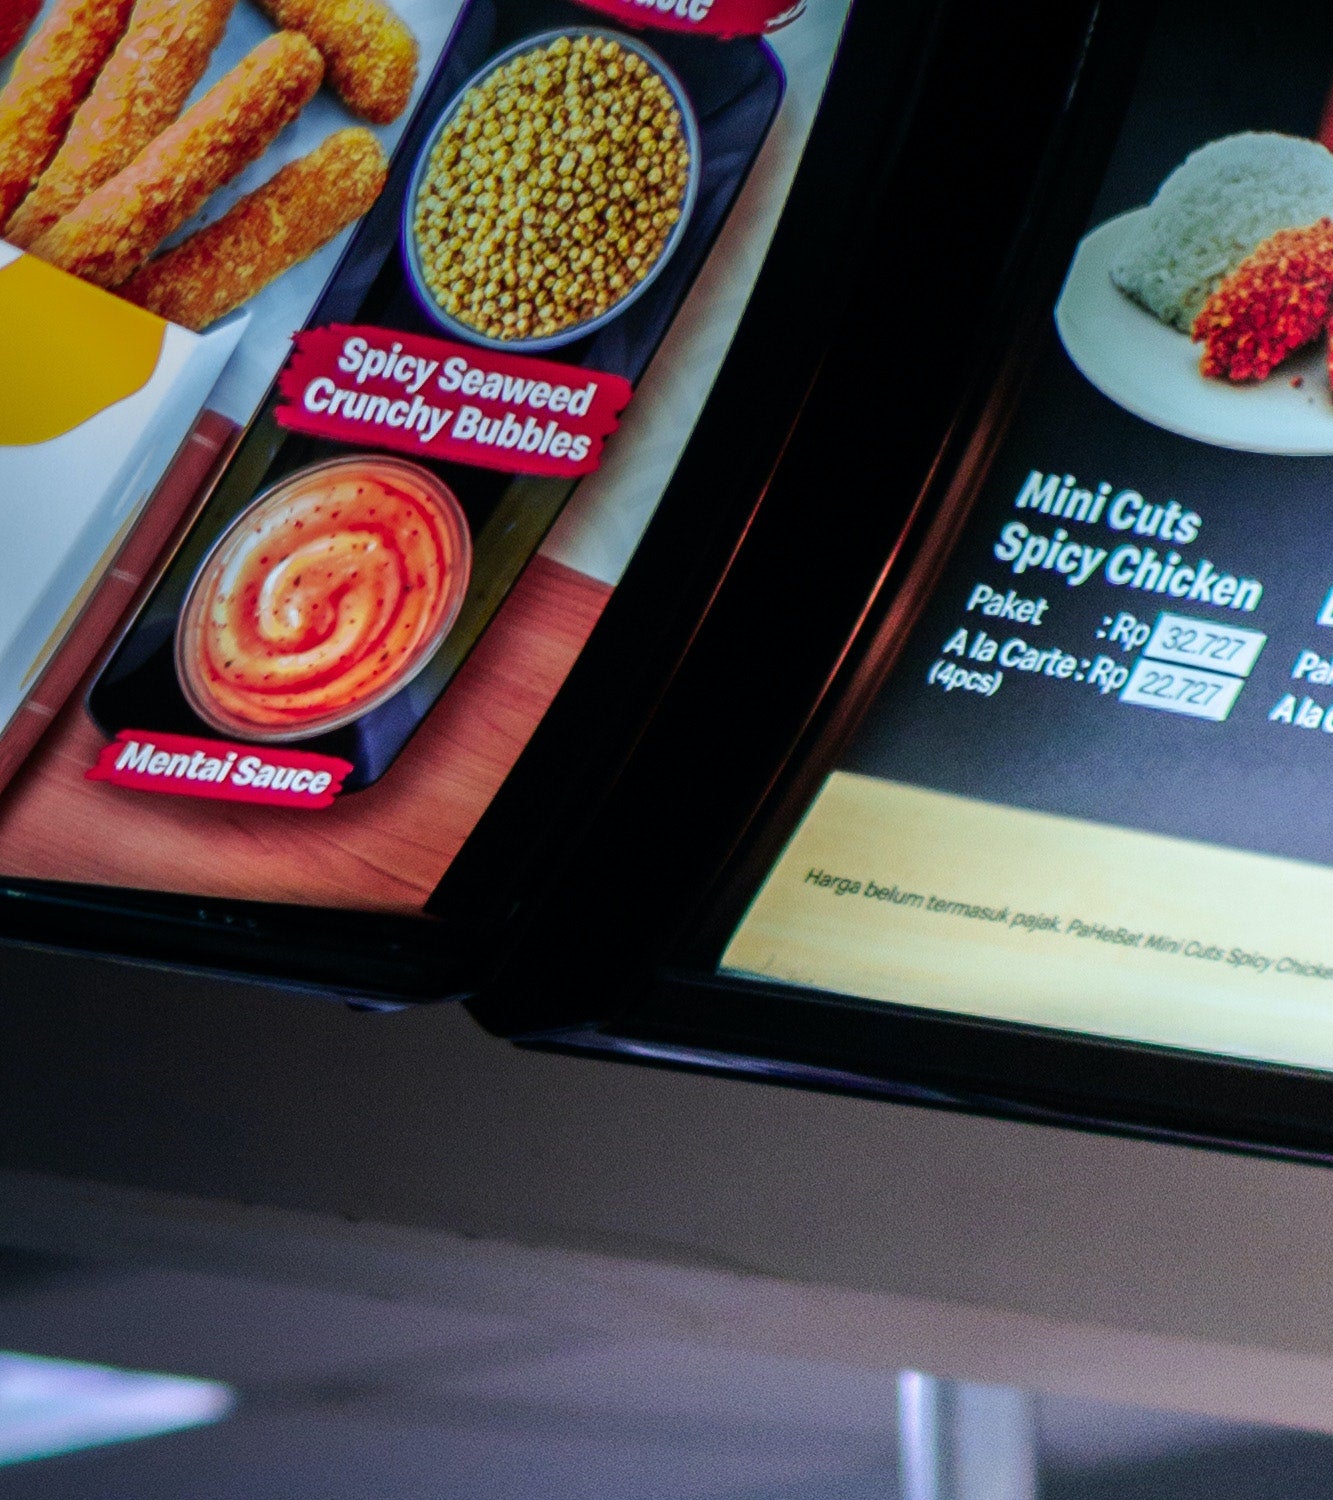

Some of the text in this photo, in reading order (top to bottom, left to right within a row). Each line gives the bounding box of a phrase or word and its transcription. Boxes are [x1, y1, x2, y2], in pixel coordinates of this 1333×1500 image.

[338, 337, 598, 416] Spicy Seaweed
[303, 377, 592, 461] Crunchy Bubbles
[1015, 470, 1203, 544] Mini Cuts
[993, 521, 1264, 612] Spicy Chicken
[966, 583, 1049, 626] Paket
[1162, 626, 1246, 661] 32.727
[927, 659, 1003, 697] (4pcs)
[943, 628, 968, 656] A
[968, 631, 999, 662] la
[1138, 671, 1223, 706] 22.727
[1268, 693, 1296, 722] A
[1294, 696, 1323, 729] la
[115, 740, 332, 794] Mentai Sauce
[804, 868, 862, 897] Harga
[864, 881, 924, 908] belum
[926, 895, 1009, 924] termasuk
[1009, 912, 1063, 934] pajak.
[1066, 919, 1143, 948] PaHeBat
